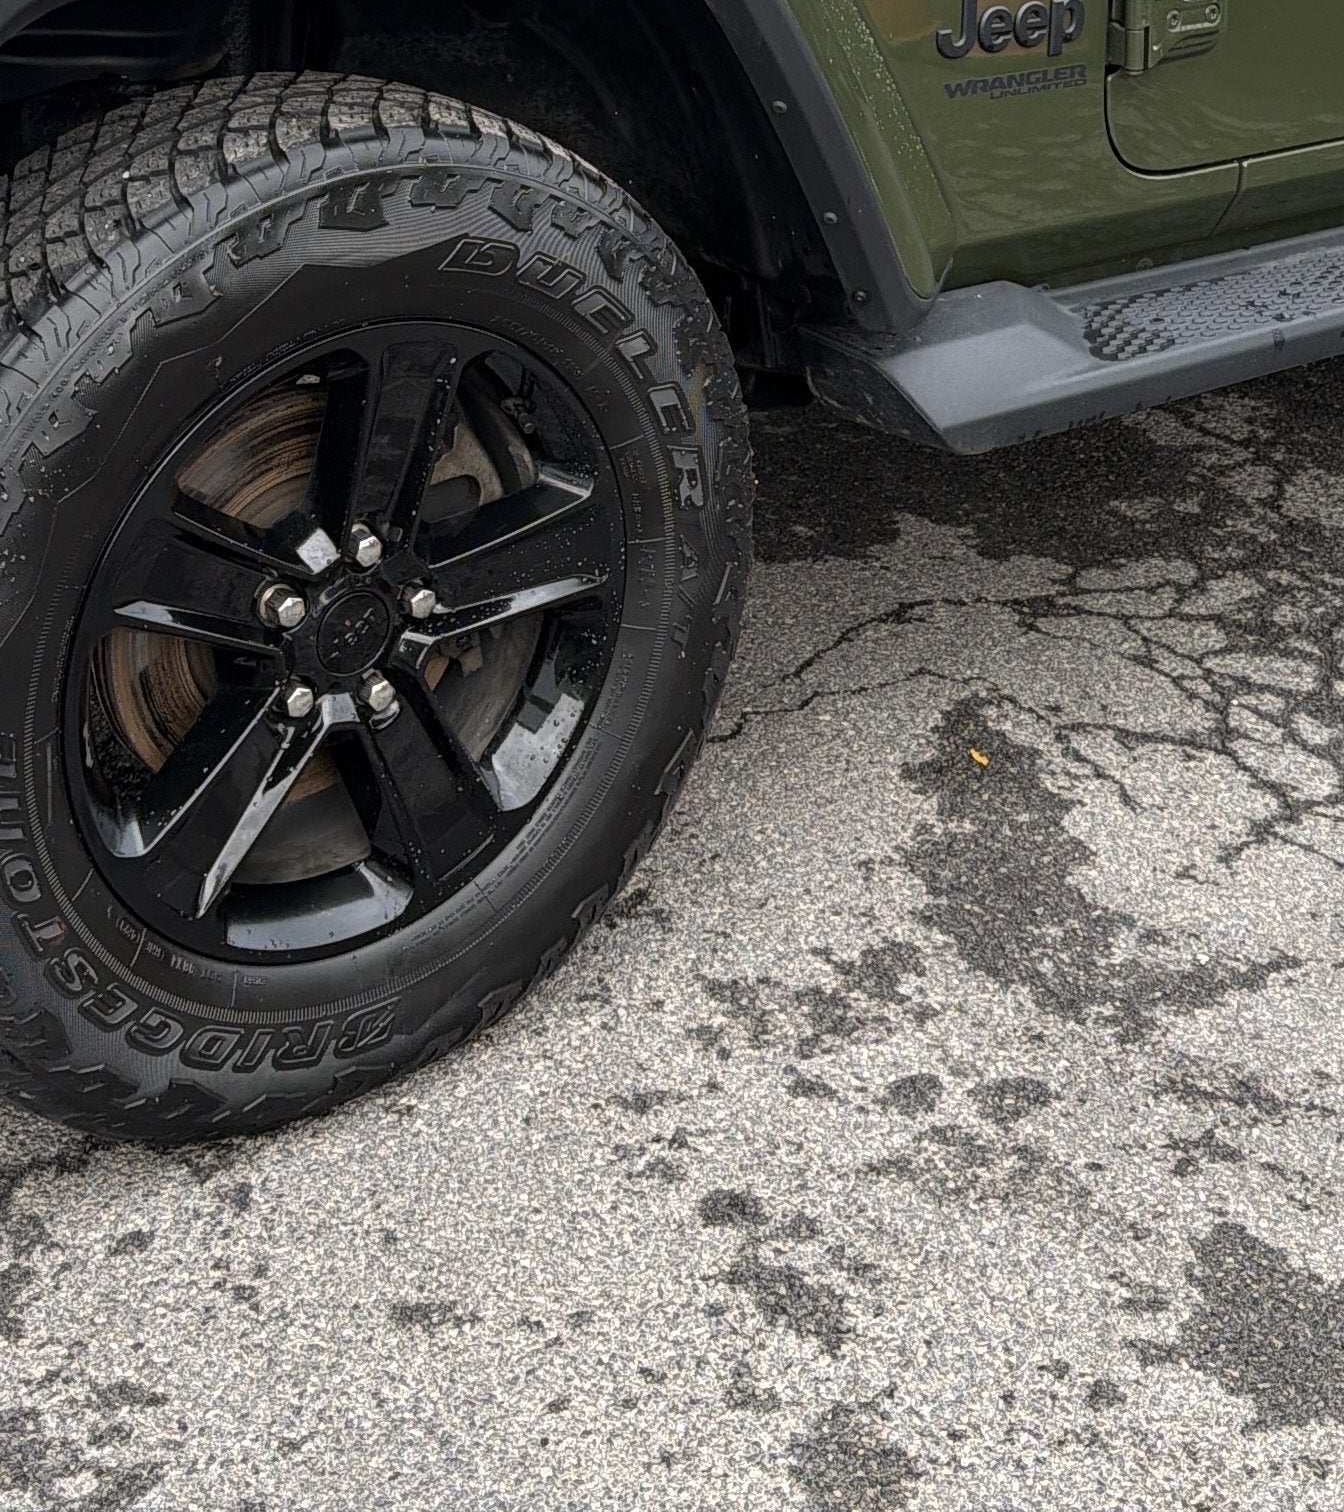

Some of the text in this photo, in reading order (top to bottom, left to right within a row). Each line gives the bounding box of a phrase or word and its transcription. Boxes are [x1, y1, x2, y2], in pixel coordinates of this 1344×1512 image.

[943, 63, 1088, 100] WRANGLER
[989, 77, 1088, 100] UNLIMITED
[437, 233, 704, 509] DUELER
